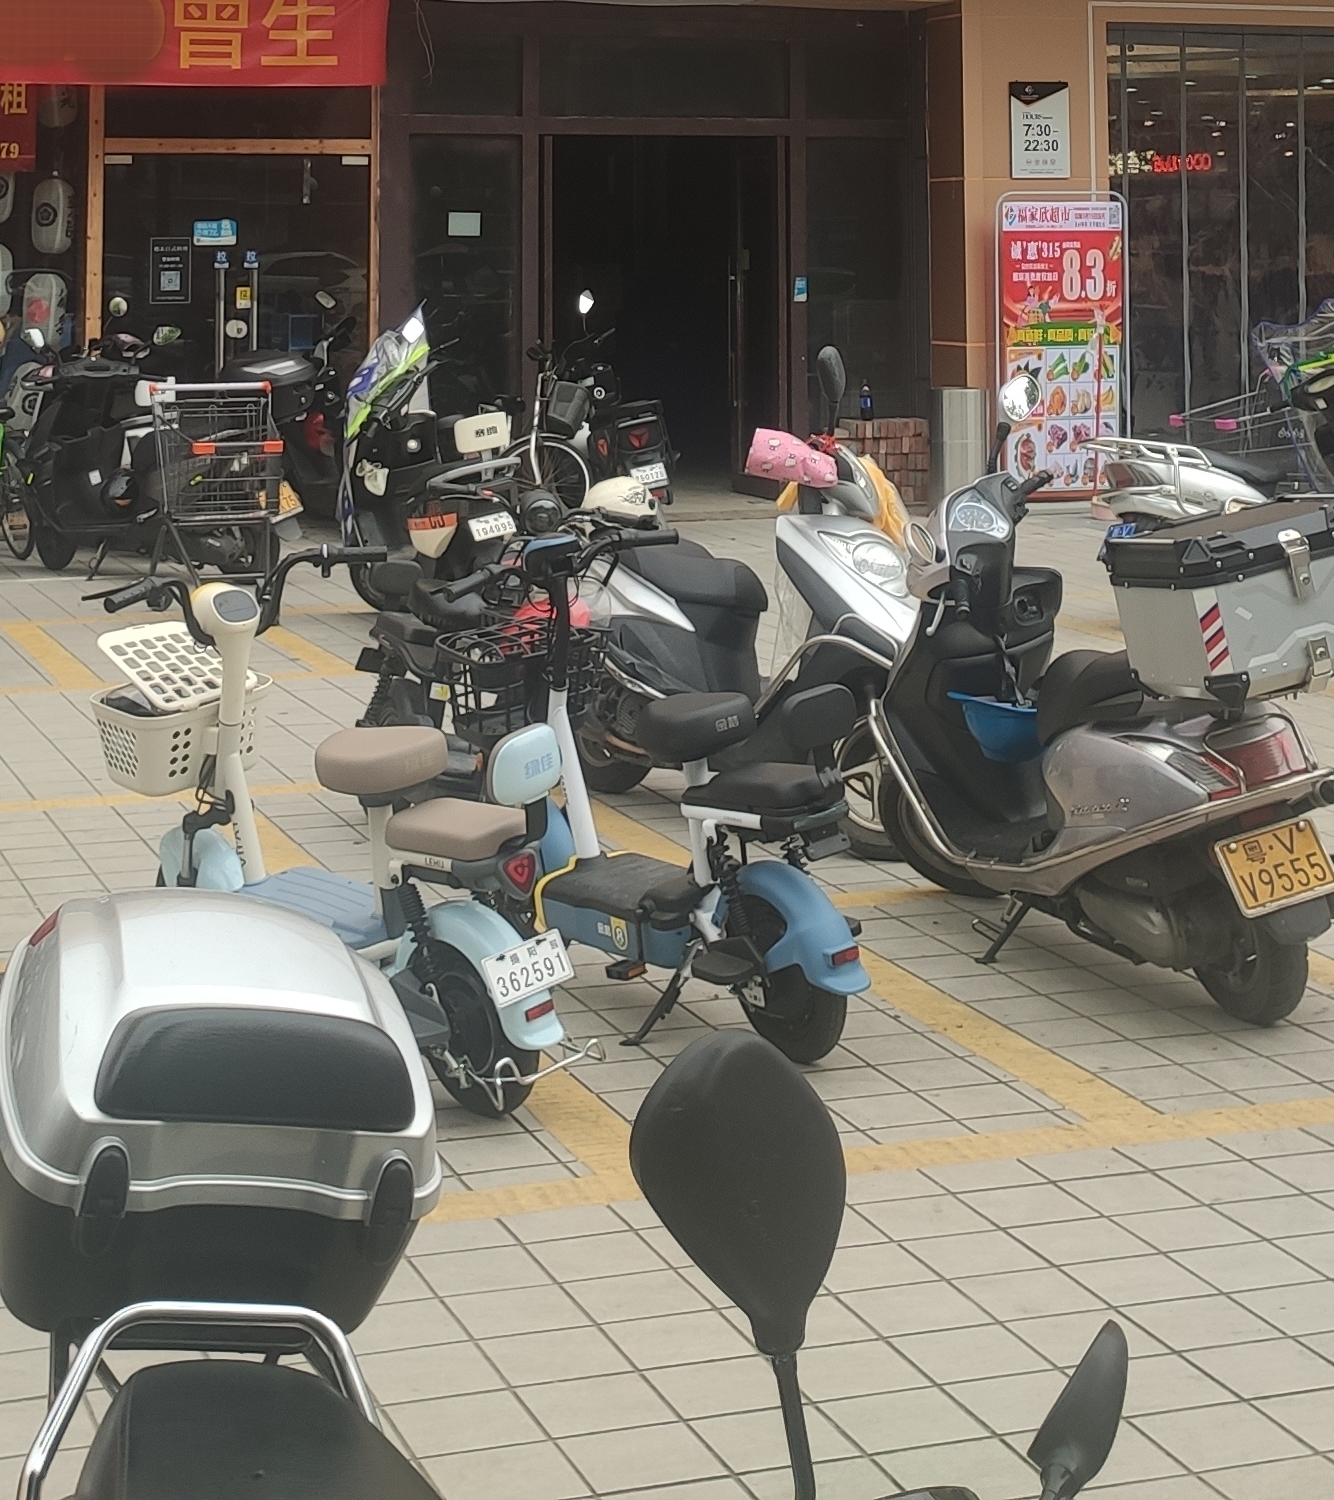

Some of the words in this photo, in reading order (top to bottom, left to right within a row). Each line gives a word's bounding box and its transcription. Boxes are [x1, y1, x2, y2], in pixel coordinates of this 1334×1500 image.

[1062, 249, 1105, 301] 8.3
[1238, 850, 1328, 904] V9555
[496, 951, 567, 998] 362591
